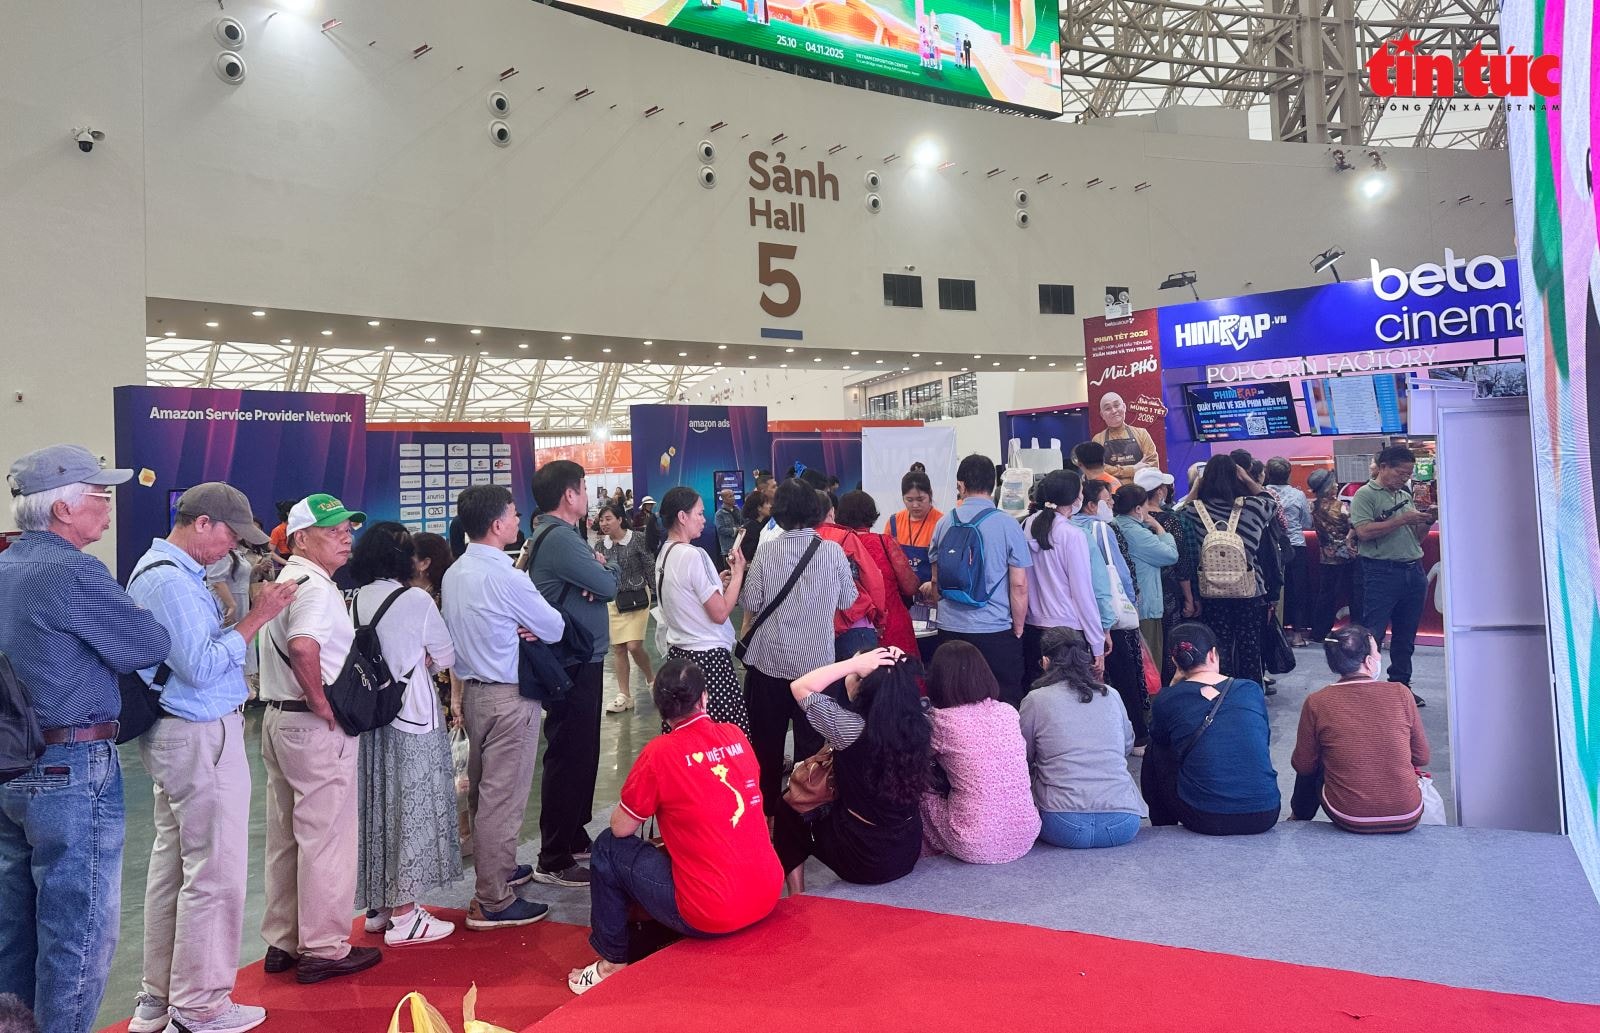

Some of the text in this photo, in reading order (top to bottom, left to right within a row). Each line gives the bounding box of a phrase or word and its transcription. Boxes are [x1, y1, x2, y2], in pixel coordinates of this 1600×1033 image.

[776, 34, 797, 48] 25.10
[805, 42, 844, 59] 04.11.2025
[748, 150, 840, 201] Sảnh
[748, 197, 806, 233] Hall
[758, 241, 802, 318] 5
[1370, 247, 1506, 301] beta
[1115, 332, 1129, 340] TẾT
[1130, 330, 1148, 338] 2026
[1207, 347, 1438, 383] POPCORN FACTORY
[150, 406, 352, 423] Amazon Service Provider Network
[1247, 399, 1261, 408] PHIM
[689, 418, 730, 430] amazon ads
[1138, 413, 1154, 423] 2026
[685, 742, 744, 766] I VIỆT NAM
